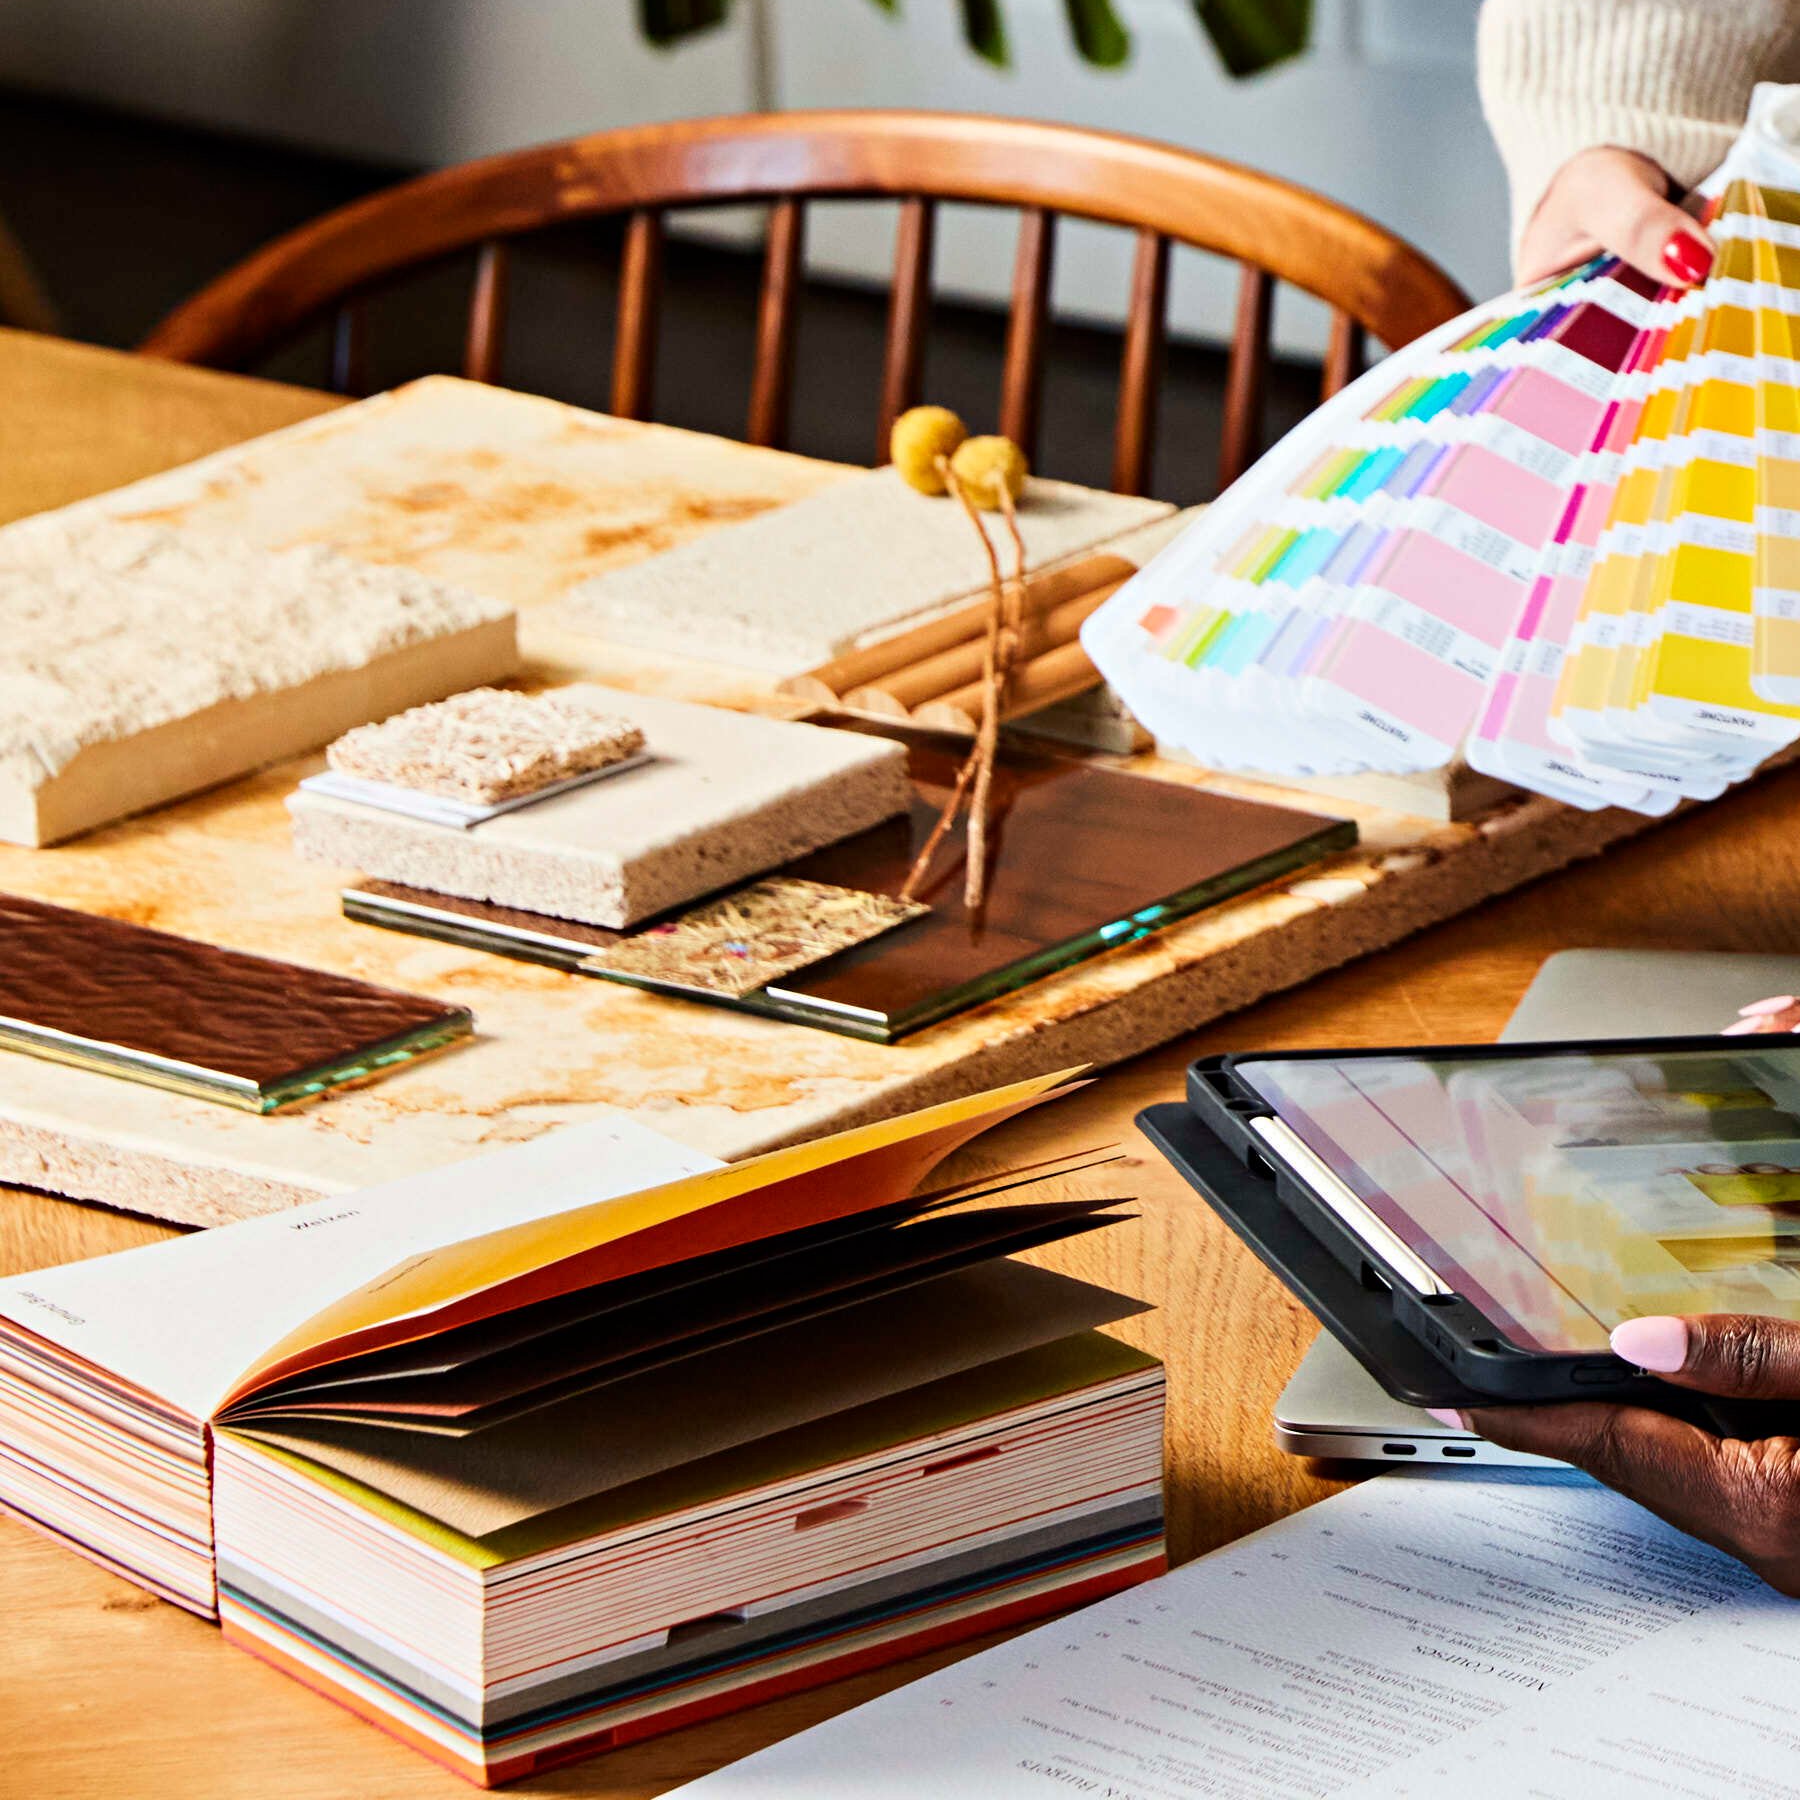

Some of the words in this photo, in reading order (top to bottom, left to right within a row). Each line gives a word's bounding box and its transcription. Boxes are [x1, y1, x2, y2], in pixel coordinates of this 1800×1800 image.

[1695, 708, 1757, 730] PANTONE
[288, 1208, 361, 1232] Weizen
[1593, 1541, 1658, 1561] Chicken
[1521, 1591, 1580, 1610] Salmon
[1601, 1585, 1654, 1602] Cheese
[1666, 1603, 1701, 1615] Mac
[1630, 1622, 1664, 1633] Pan
[1404, 1643, 1500, 1675] Courses
[1285, 1670, 1360, 1696] Sandwich
[1346, 1666, 1423, 1692] Sandwich
[1490, 1668, 1557, 1691] Main
[1223, 1697, 1301, 1723] Sandwich
[1010, 1757, 1103, 1791] Burgers
